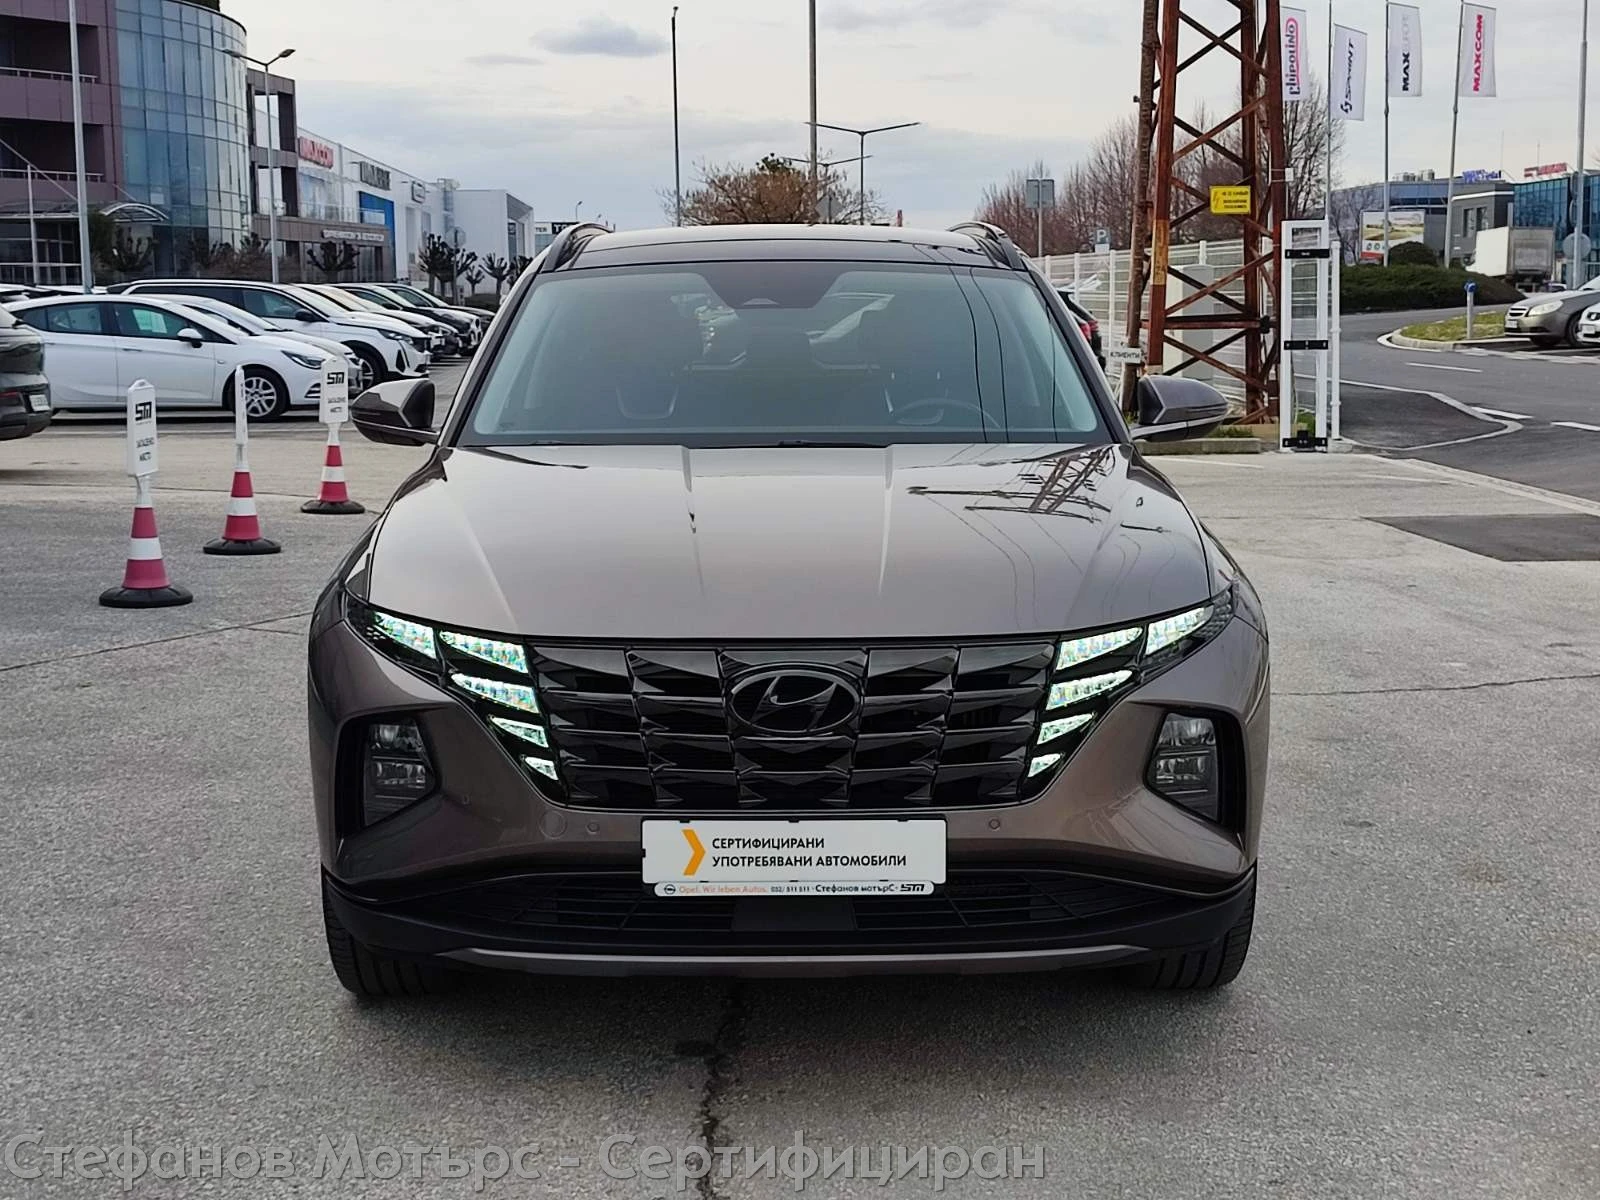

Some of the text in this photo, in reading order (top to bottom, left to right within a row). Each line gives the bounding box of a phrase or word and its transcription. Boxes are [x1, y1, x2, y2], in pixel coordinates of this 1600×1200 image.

[1472, 14, 1484, 92] MAXCOM
[1096, 229, 1107, 242] P
[712, 837, 825, 850] СЕРТИФИЦИРАНИ
[712, 855, 907, 867] УПОТРЕБЯВАНИ АВТОМОБИЛИ
[815, 884, 859, 893] Стефанов
